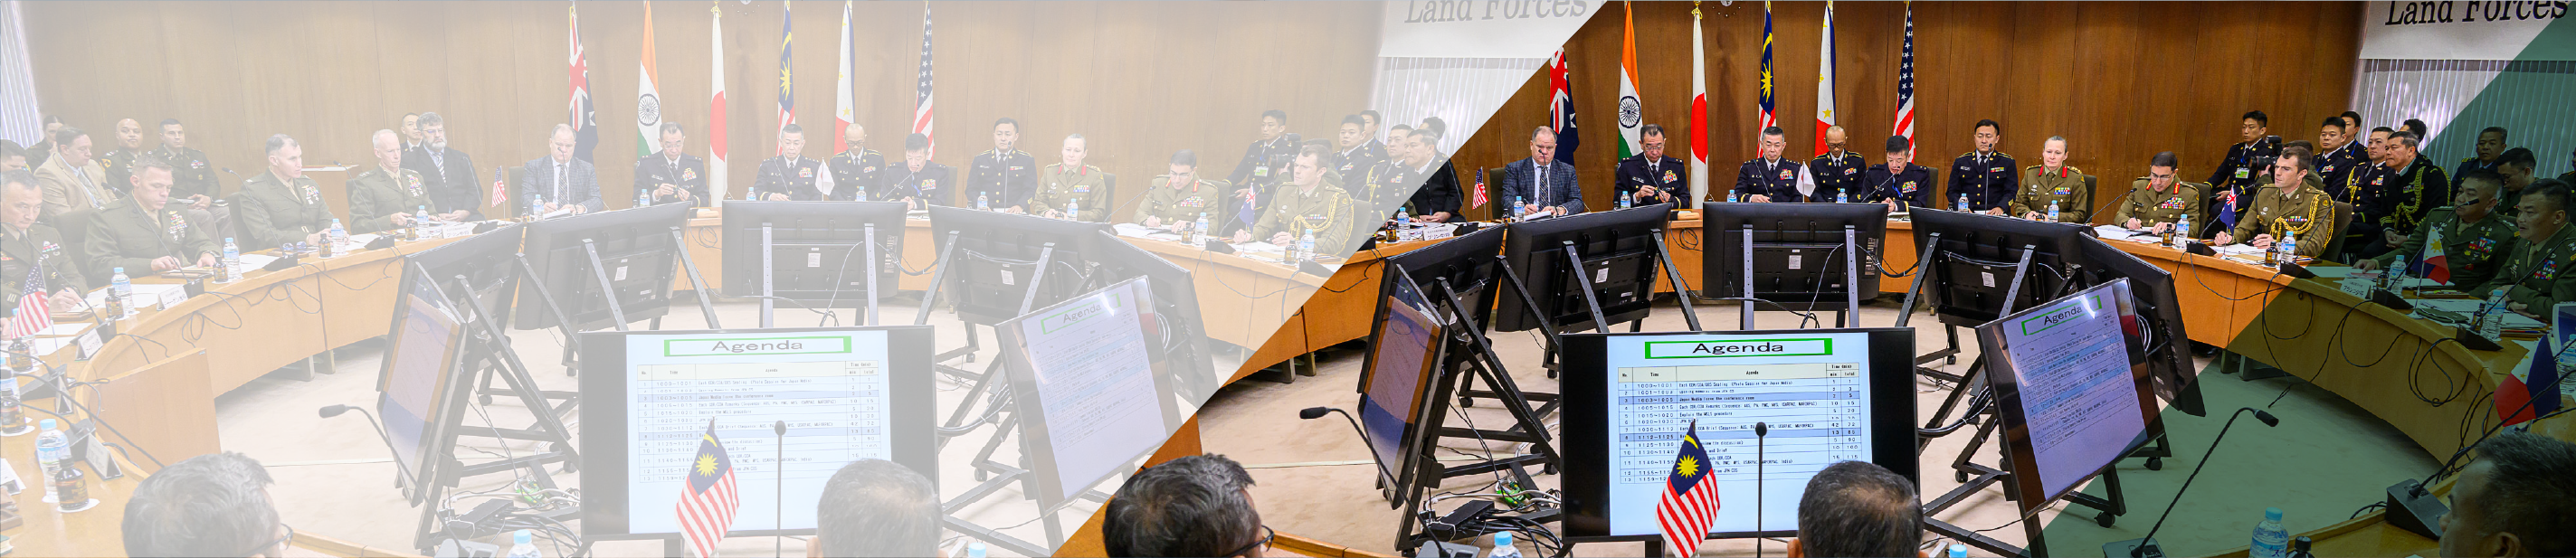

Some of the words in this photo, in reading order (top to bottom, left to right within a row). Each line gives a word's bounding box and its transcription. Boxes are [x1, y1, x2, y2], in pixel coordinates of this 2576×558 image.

[1404, 0, 1473, 23] Land
[1482, 0, 1587, 20] Forces
[2385, 0, 2454, 25] Land
[2462, 0, 2568, 22] Forces
[1063, 304, 1101, 324] Agenda
[2044, 306, 2082, 326] Agenda
[712, 340, 803, 353] Agenda
[1693, 342, 1784, 355] Agenda
